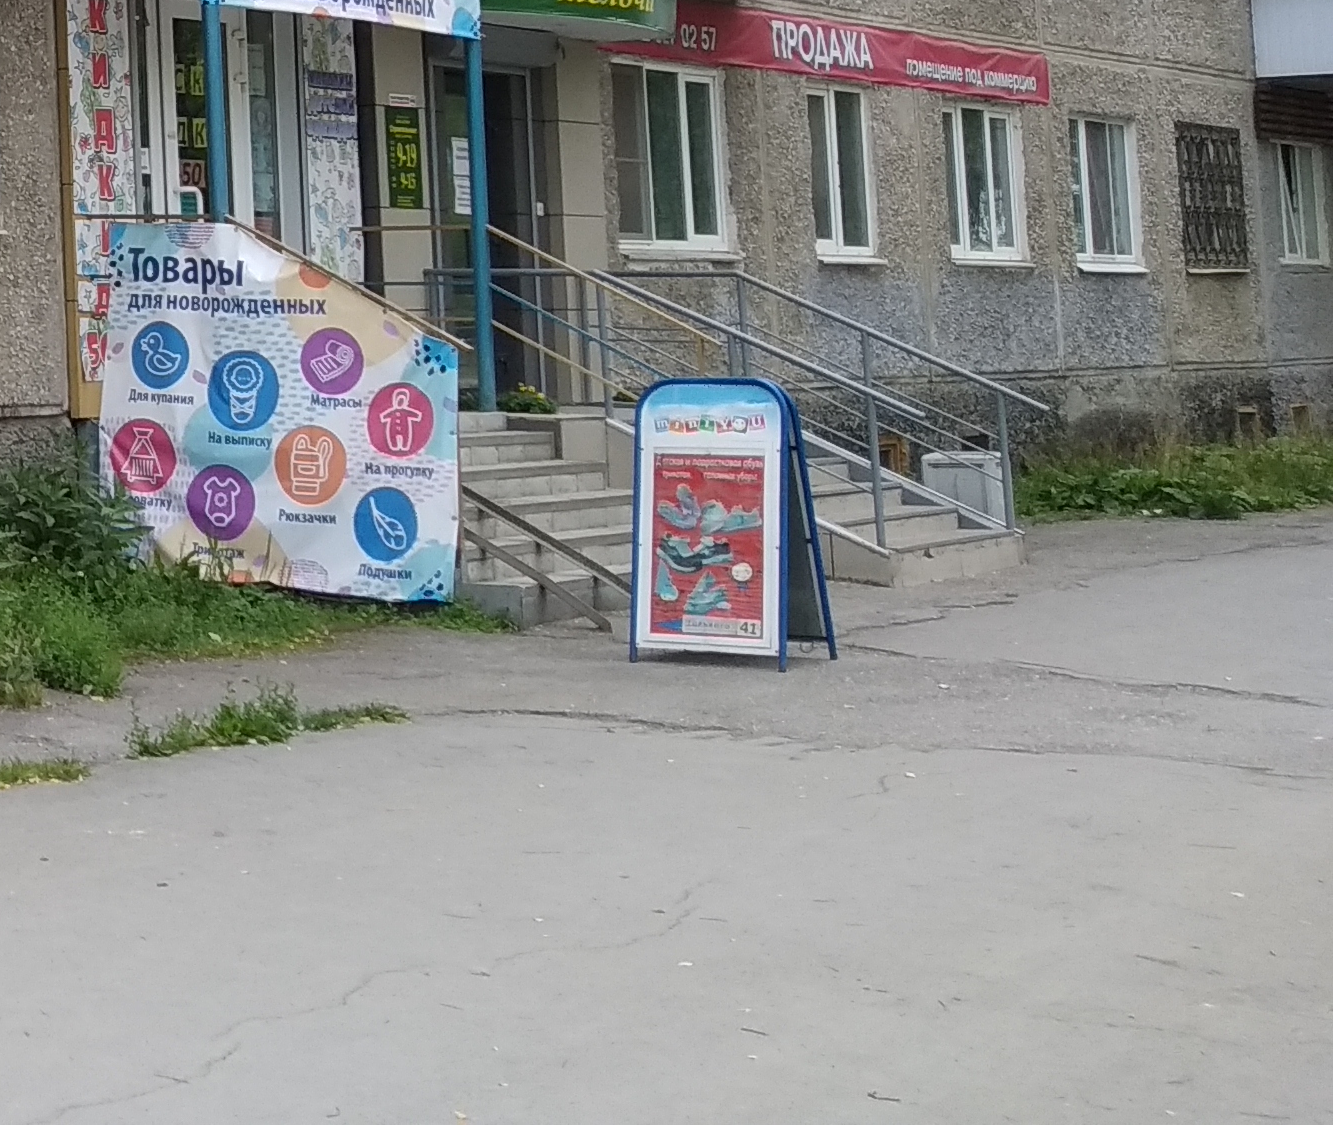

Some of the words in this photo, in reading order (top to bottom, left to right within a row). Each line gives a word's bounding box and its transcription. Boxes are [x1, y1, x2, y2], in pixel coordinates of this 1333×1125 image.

[680, 23, 698, 50] 02
[701, 25, 717, 52] 57
[771, 20, 874, 72] ПРОДАЖА
[906, 58, 963, 83] помещение
[964, 67, 983, 86] под
[128, 247, 244, 294] Товары
[128, 293, 162, 312] для
[166, 294, 327, 318] новорожденных
[128, 389, 148, 403] Для
[150, 392, 194, 405] купания
[310, 394, 362, 408] Матрасы
[208, 431, 222, 444] На
[225, 435, 273, 450] выписку
[365, 462, 383, 476] На
[384, 464, 434, 480] прогулку
[278, 509, 337, 524] Рюкзачки
[358, 563, 412, 580] Подушки
[739, 621, 757, 635] 41
